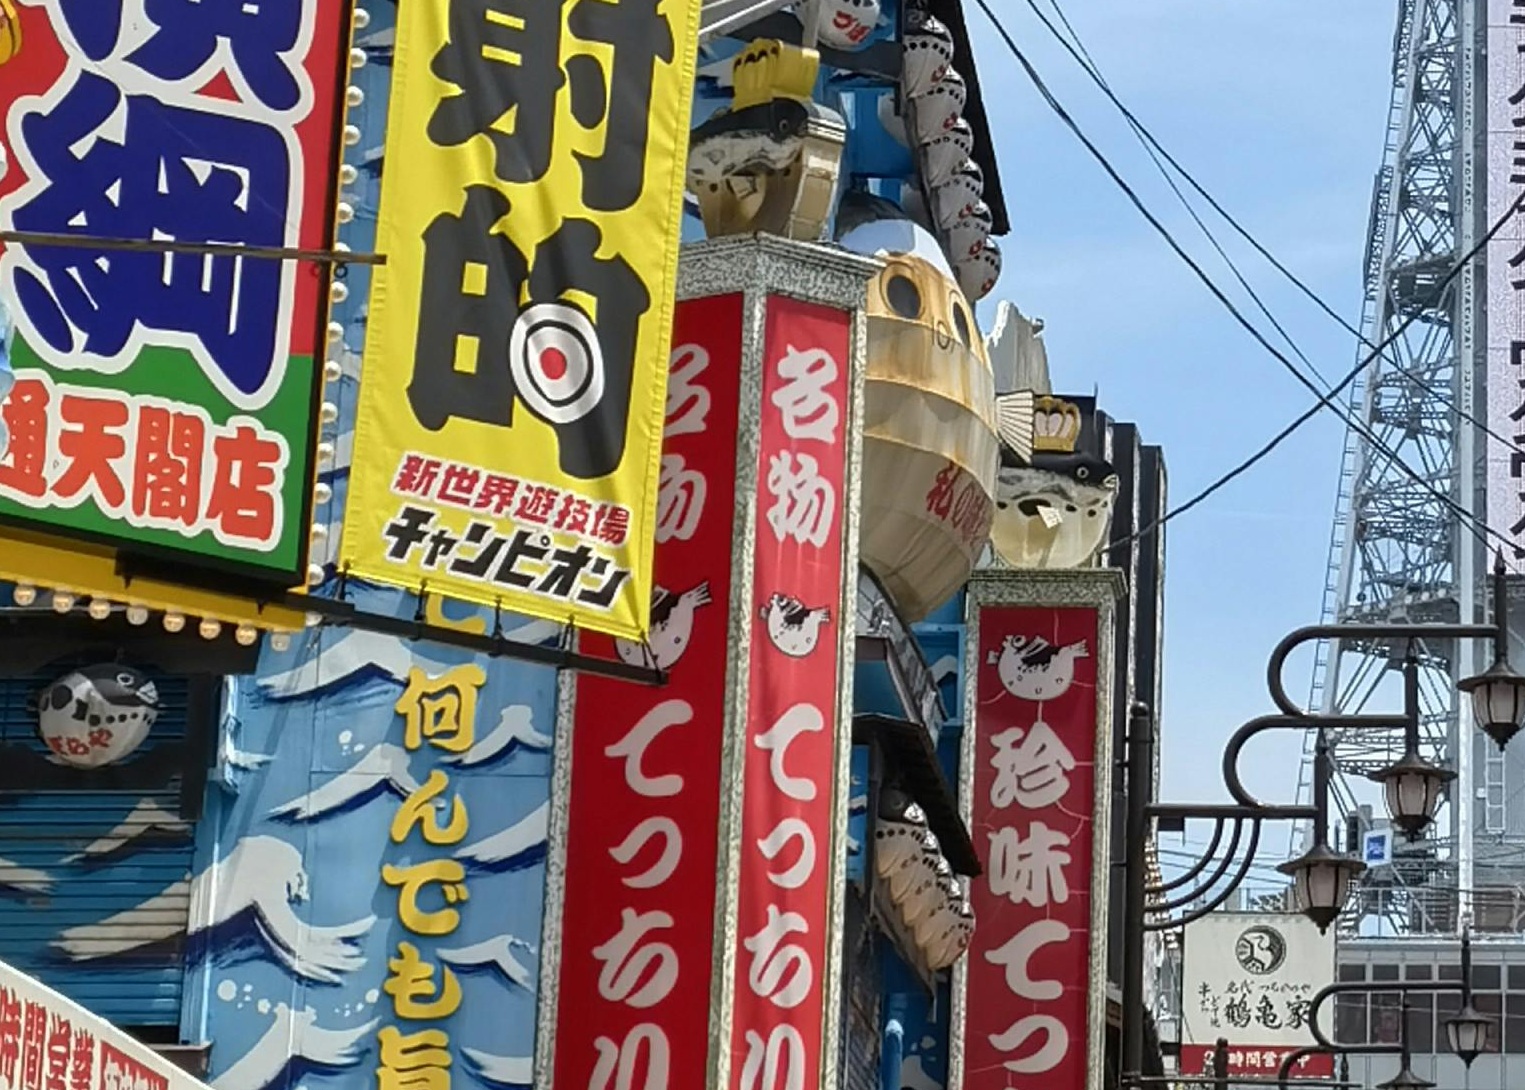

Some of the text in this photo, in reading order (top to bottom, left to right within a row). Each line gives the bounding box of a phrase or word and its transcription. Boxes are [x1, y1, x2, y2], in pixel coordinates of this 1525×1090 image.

[0, 380, 280, 541] 通天閣店
[397, 455, 632, 545] 新世界遊技場
[766, 345, 840, 549] 名物
[383, 507, 630, 610] チャンピオン
